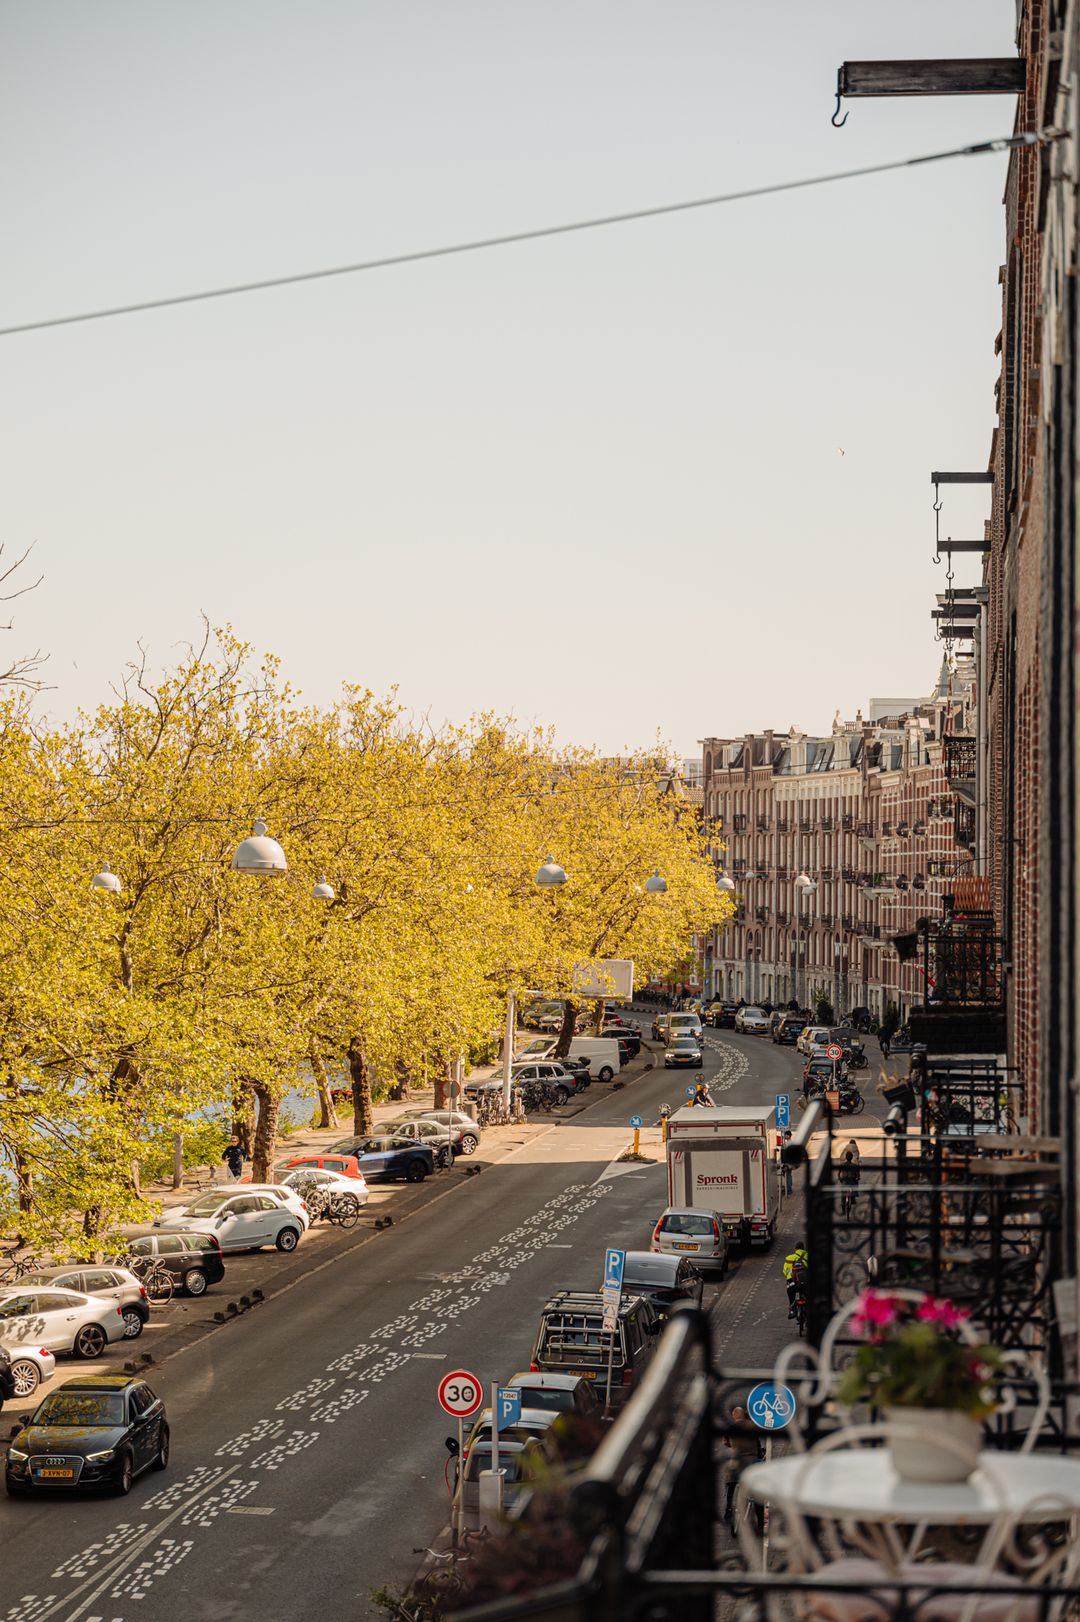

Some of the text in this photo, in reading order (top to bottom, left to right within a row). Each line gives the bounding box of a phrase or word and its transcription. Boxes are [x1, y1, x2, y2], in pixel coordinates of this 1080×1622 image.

[829, 1048, 840, 1056] 30
[779, 1096, 786, 1106] P
[777, 1107, 786, 1118] P
[697, 1174, 738, 1185] Spronk
[608, 1252, 620, 1273] P
[447, 1385, 475, 1402] 30
[503, 1401, 513, 1418] P
